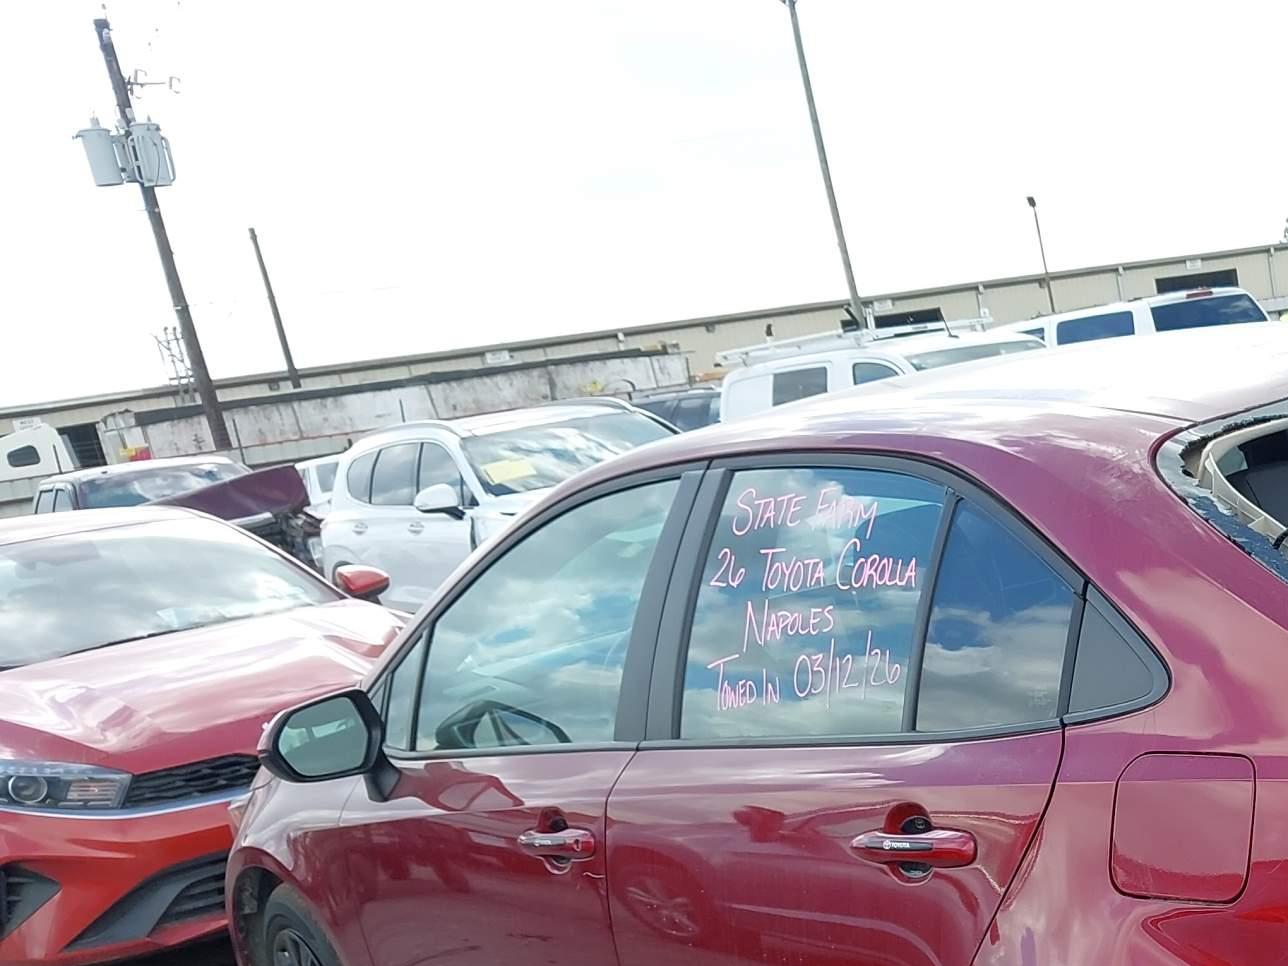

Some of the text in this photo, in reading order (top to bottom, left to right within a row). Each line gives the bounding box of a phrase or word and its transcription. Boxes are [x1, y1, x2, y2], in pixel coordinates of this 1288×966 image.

[732, 486, 878, 539] STATE FARM
[709, 538, 917, 592] 26 TOYOTA COROLLA
[743, 599, 835, 652] NAPOLES
[707, 629, 901, 712] TOWED IN 03/12/26
